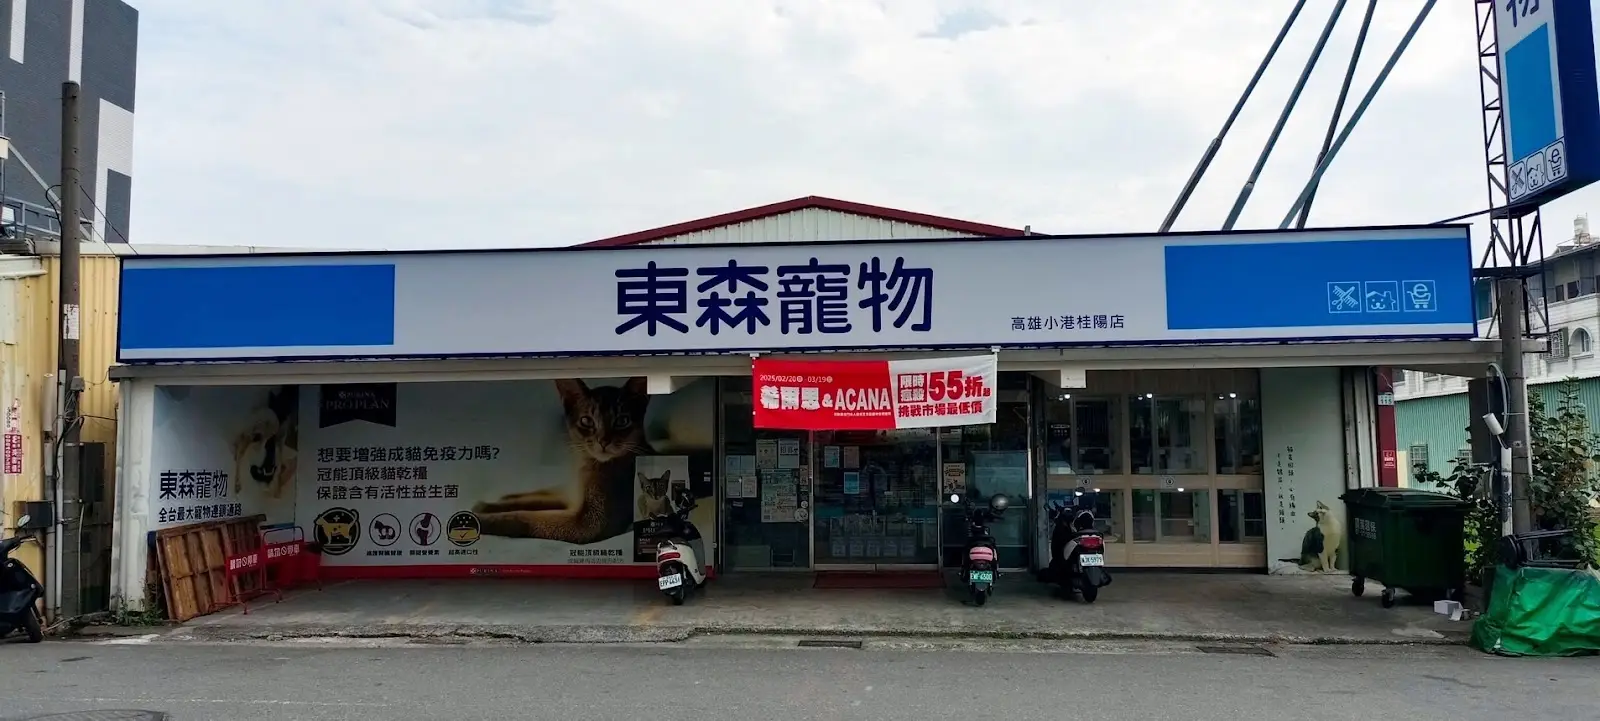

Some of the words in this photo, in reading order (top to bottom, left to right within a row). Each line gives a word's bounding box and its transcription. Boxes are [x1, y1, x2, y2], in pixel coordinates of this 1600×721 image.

[614, 256, 934, 337] 東森寵物
[1010, 314, 1125, 331] 高雄小港桂陽店
[900, 374, 924, 388] 限時
[834, 388, 891, 411] ACANA
[898, 401, 983, 418] 挑戰市場最低價
[317, 445, 500, 463] 想要增強成貓免疫力嗎?
[316, 466, 428, 482] 冠能頂級貓乾糧
[159, 469, 228, 500] 東森寵物
[316, 484, 459, 501] 保證含有活性益生菌
[158, 503, 242, 523] 全台最大寵物連鎖通路
